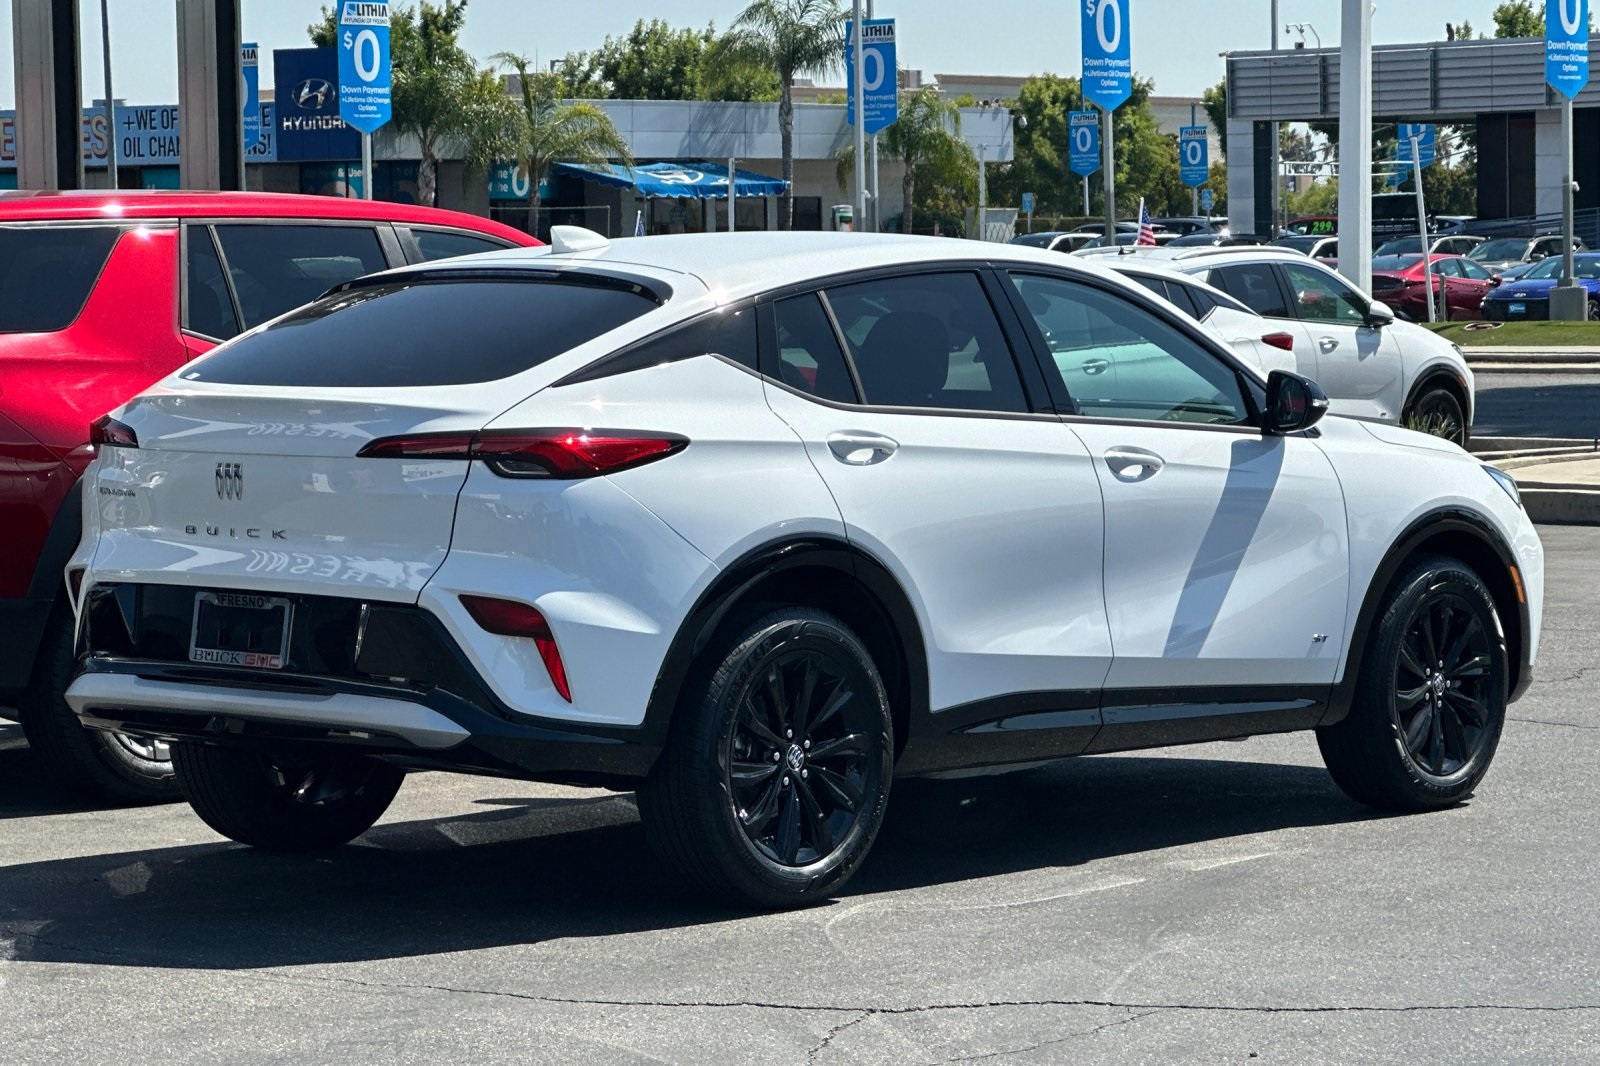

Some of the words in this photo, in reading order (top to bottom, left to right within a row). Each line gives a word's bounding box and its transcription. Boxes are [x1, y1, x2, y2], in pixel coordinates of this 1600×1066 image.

[356, 4, 387, 17] LITHIA
[1547, 41, 1565, 50] Down
[1083, 57, 1103, 66] Down
[1562, 63, 1578, 72] Options
[1100, 79, 1119, 87] Options
[341, 85, 361, 94] Down
[123, 136, 145, 158] OIL
[348, 168, 362, 177] Use
[1312, 220, 1333, 232] 299
[184, 524, 288, 541] BUICK
[220, 592, 264, 609] FRESNO
[193, 649, 241, 665] BUICK
[244, 653, 281, 668] GMC
